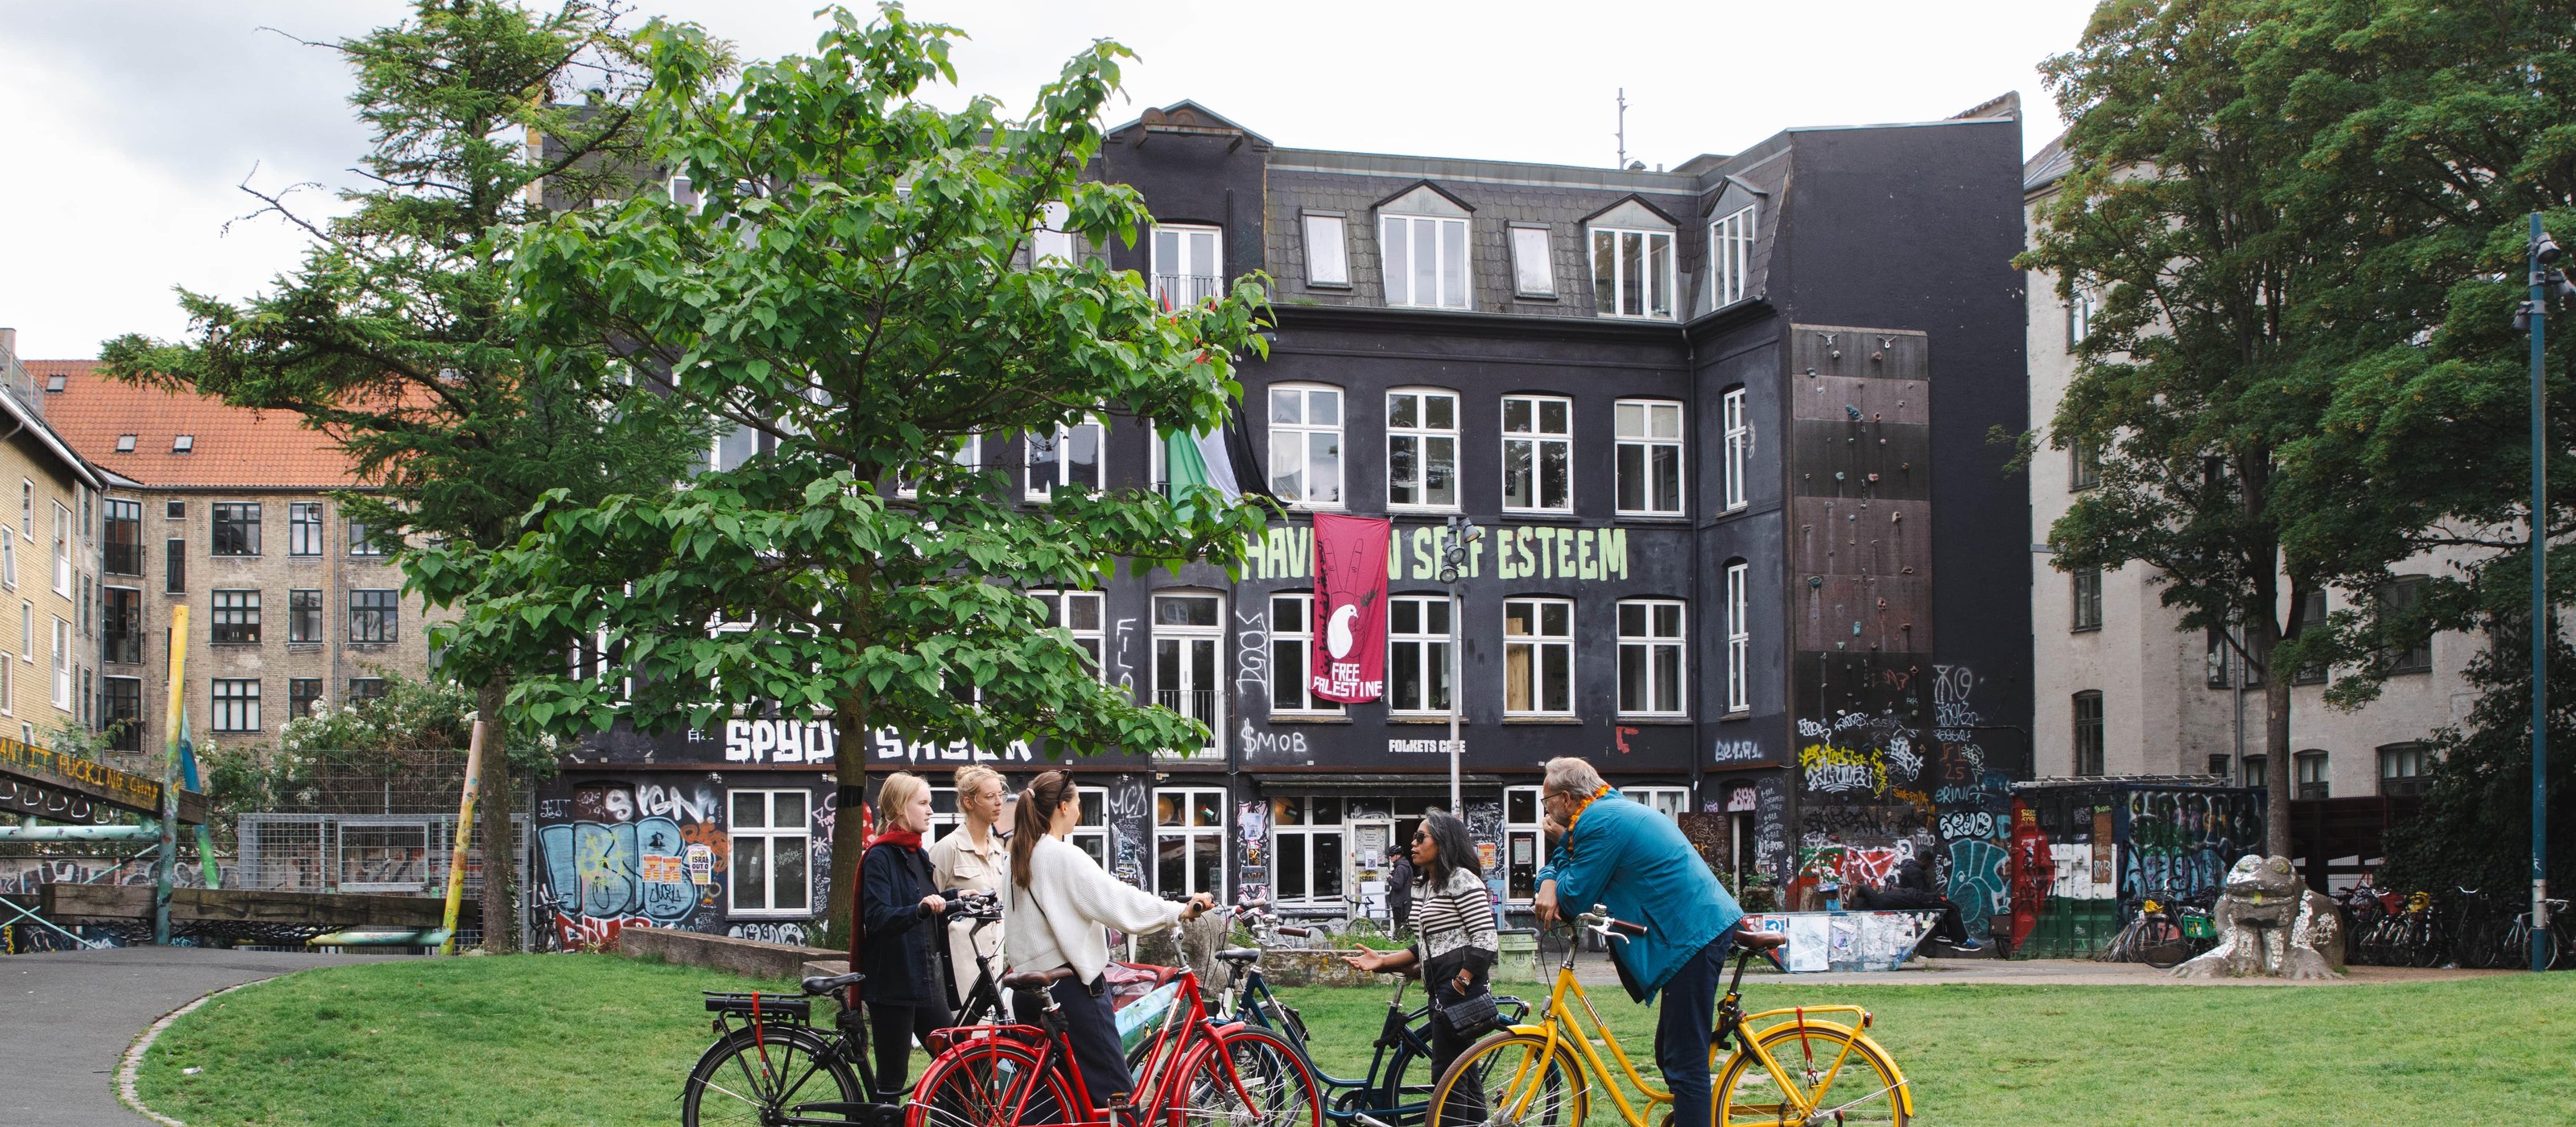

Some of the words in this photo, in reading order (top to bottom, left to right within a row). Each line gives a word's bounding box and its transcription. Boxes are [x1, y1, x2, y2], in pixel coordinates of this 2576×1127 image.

[1241, 526, 1314, 580] HAV
[1497, 526, 1628, 581] ESTEEM
[1331, 662, 1360, 683] FREE
[1311, 675, 1383, 698] PALESTINE
[1389, 739, 1437, 753] FOLKETS
[1439, 740, 1466, 753] CAE
[58, 753, 123, 790] FUCKING
